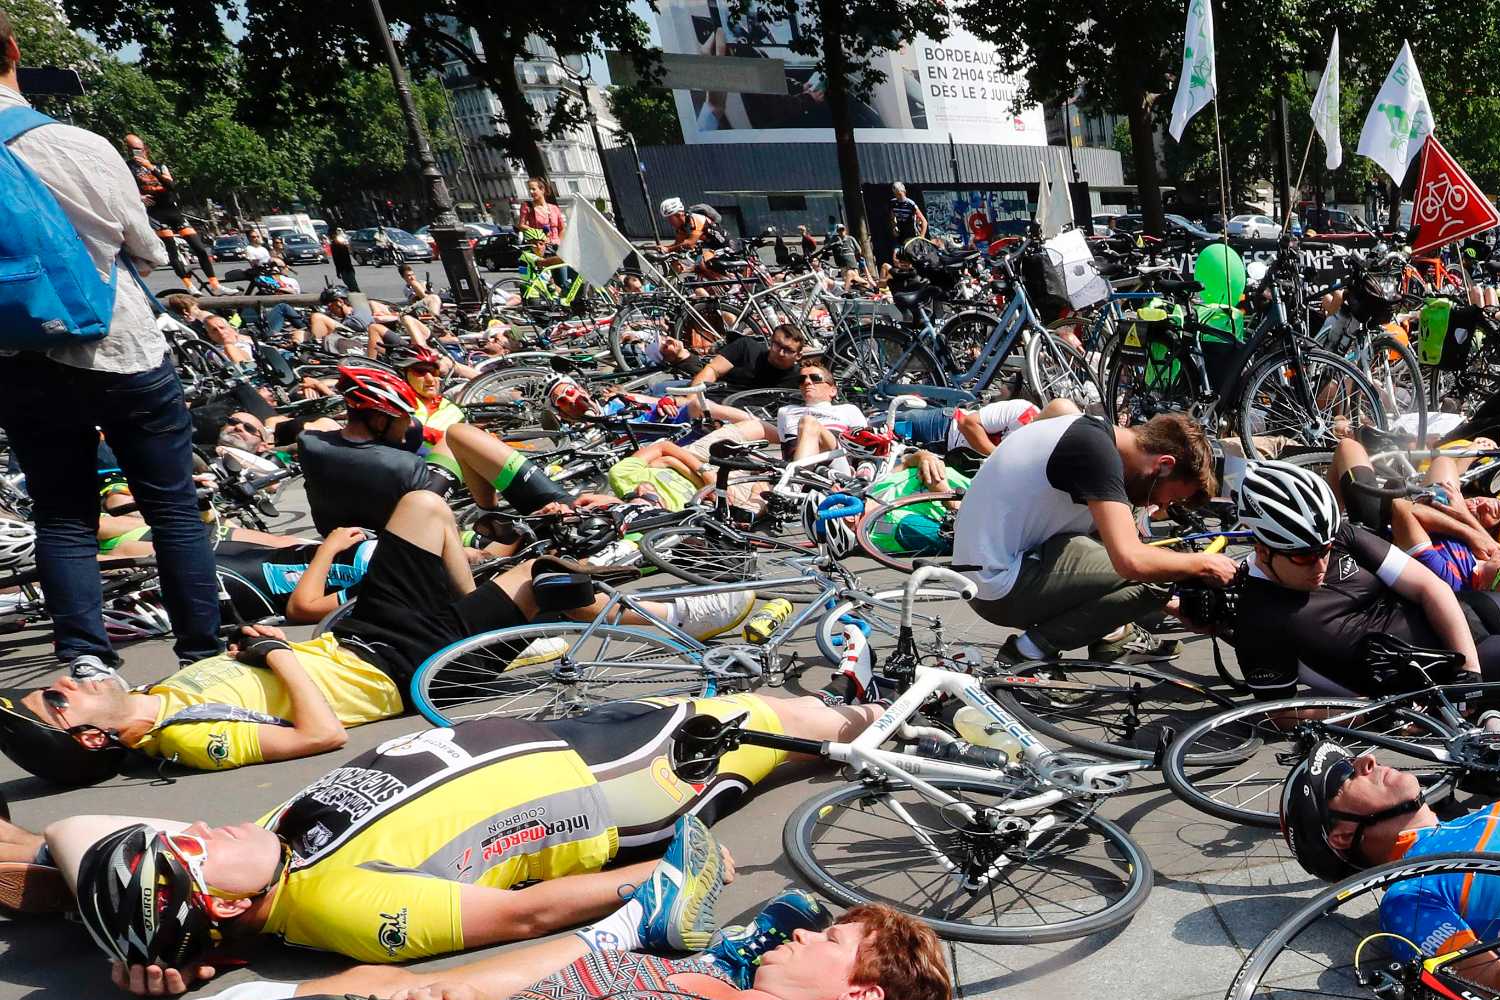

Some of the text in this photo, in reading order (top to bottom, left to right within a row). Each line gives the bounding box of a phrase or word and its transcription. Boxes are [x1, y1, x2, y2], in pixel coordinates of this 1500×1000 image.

[927, 66, 949, 80] EN
[952, 67, 985, 81] 2H04
[930, 82, 958, 98] DÈS
[961, 86, 977, 99] LE
[980, 87, 988, 100] 2
[488, 806, 546, 834] COUBRON
[143, 887, 153, 918] GIRO
